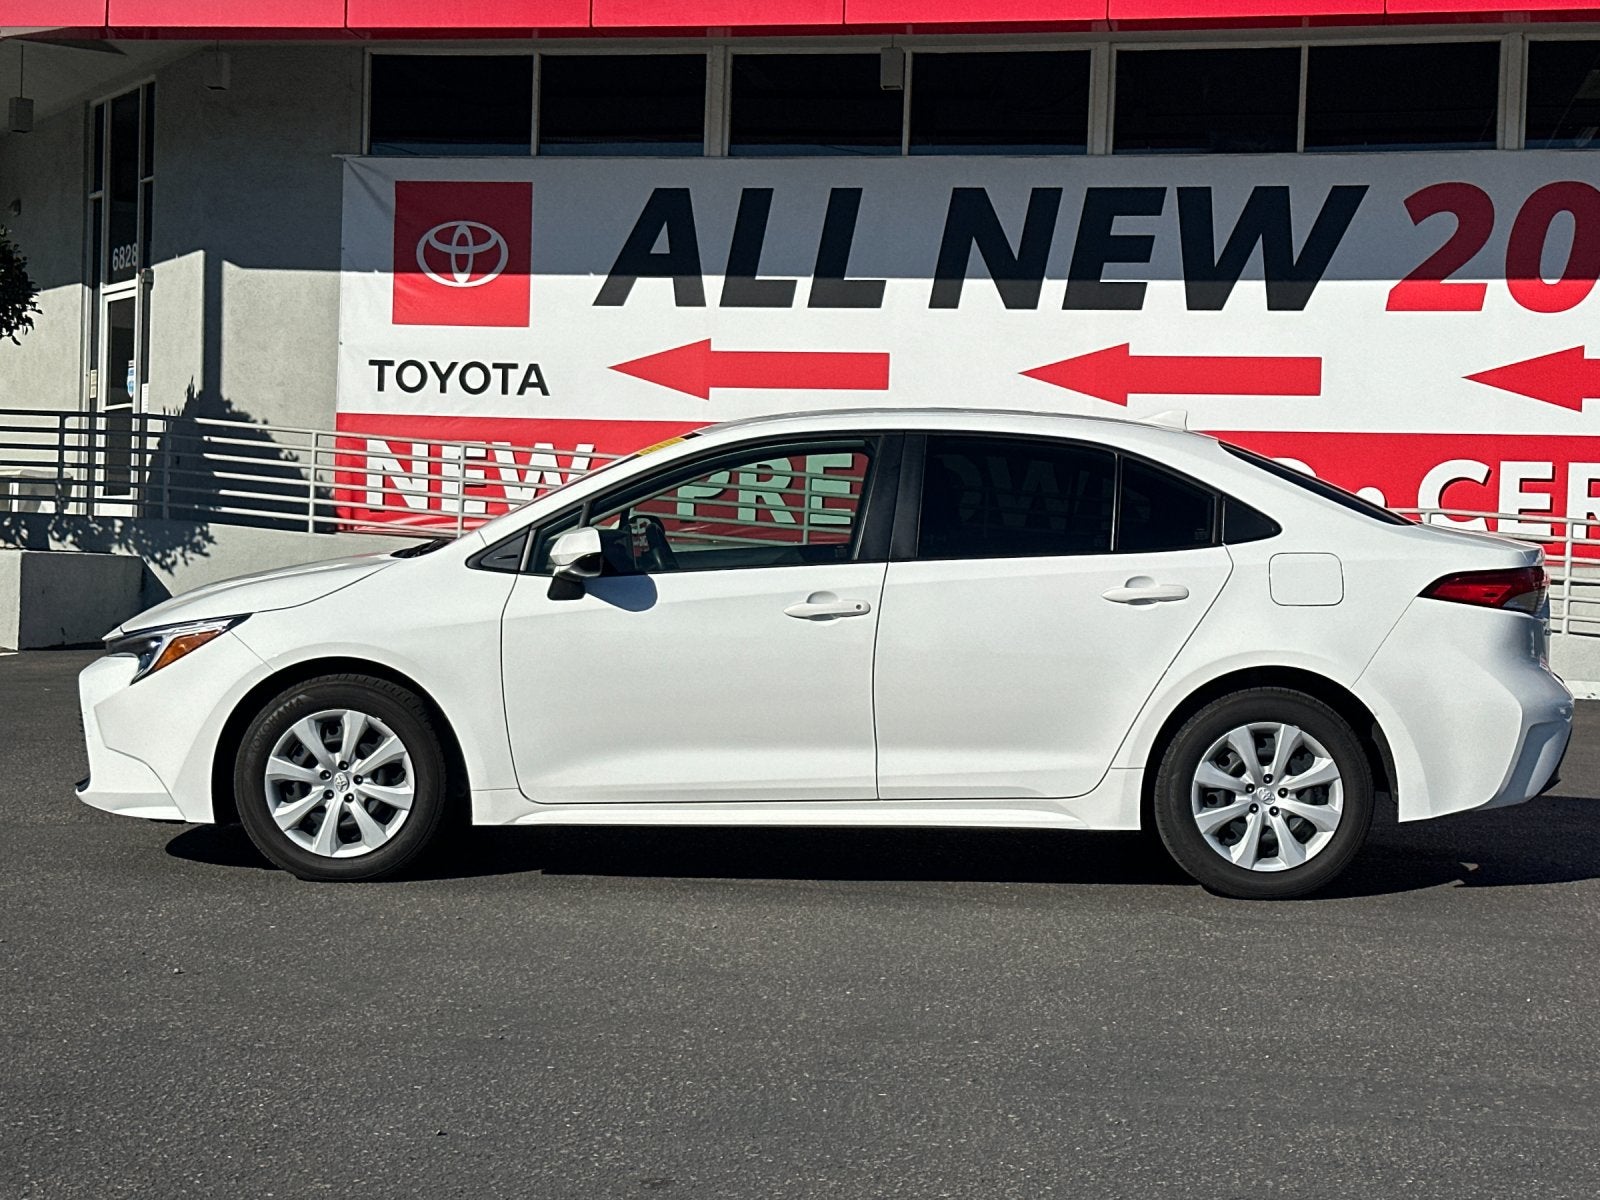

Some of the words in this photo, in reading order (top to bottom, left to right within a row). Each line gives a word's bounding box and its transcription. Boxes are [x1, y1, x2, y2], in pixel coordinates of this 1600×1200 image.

[112, 242, 138, 271] 6828
[592, 187, 887, 309] ALL
[928, 185, 1370, 311] NEW
[1385, 180, 1600, 313] 20
[368, 359, 550, 396] TOYOTA
[366, 439, 595, 514] NEW
[248, 696, 304, 753] YOKOHAMA
